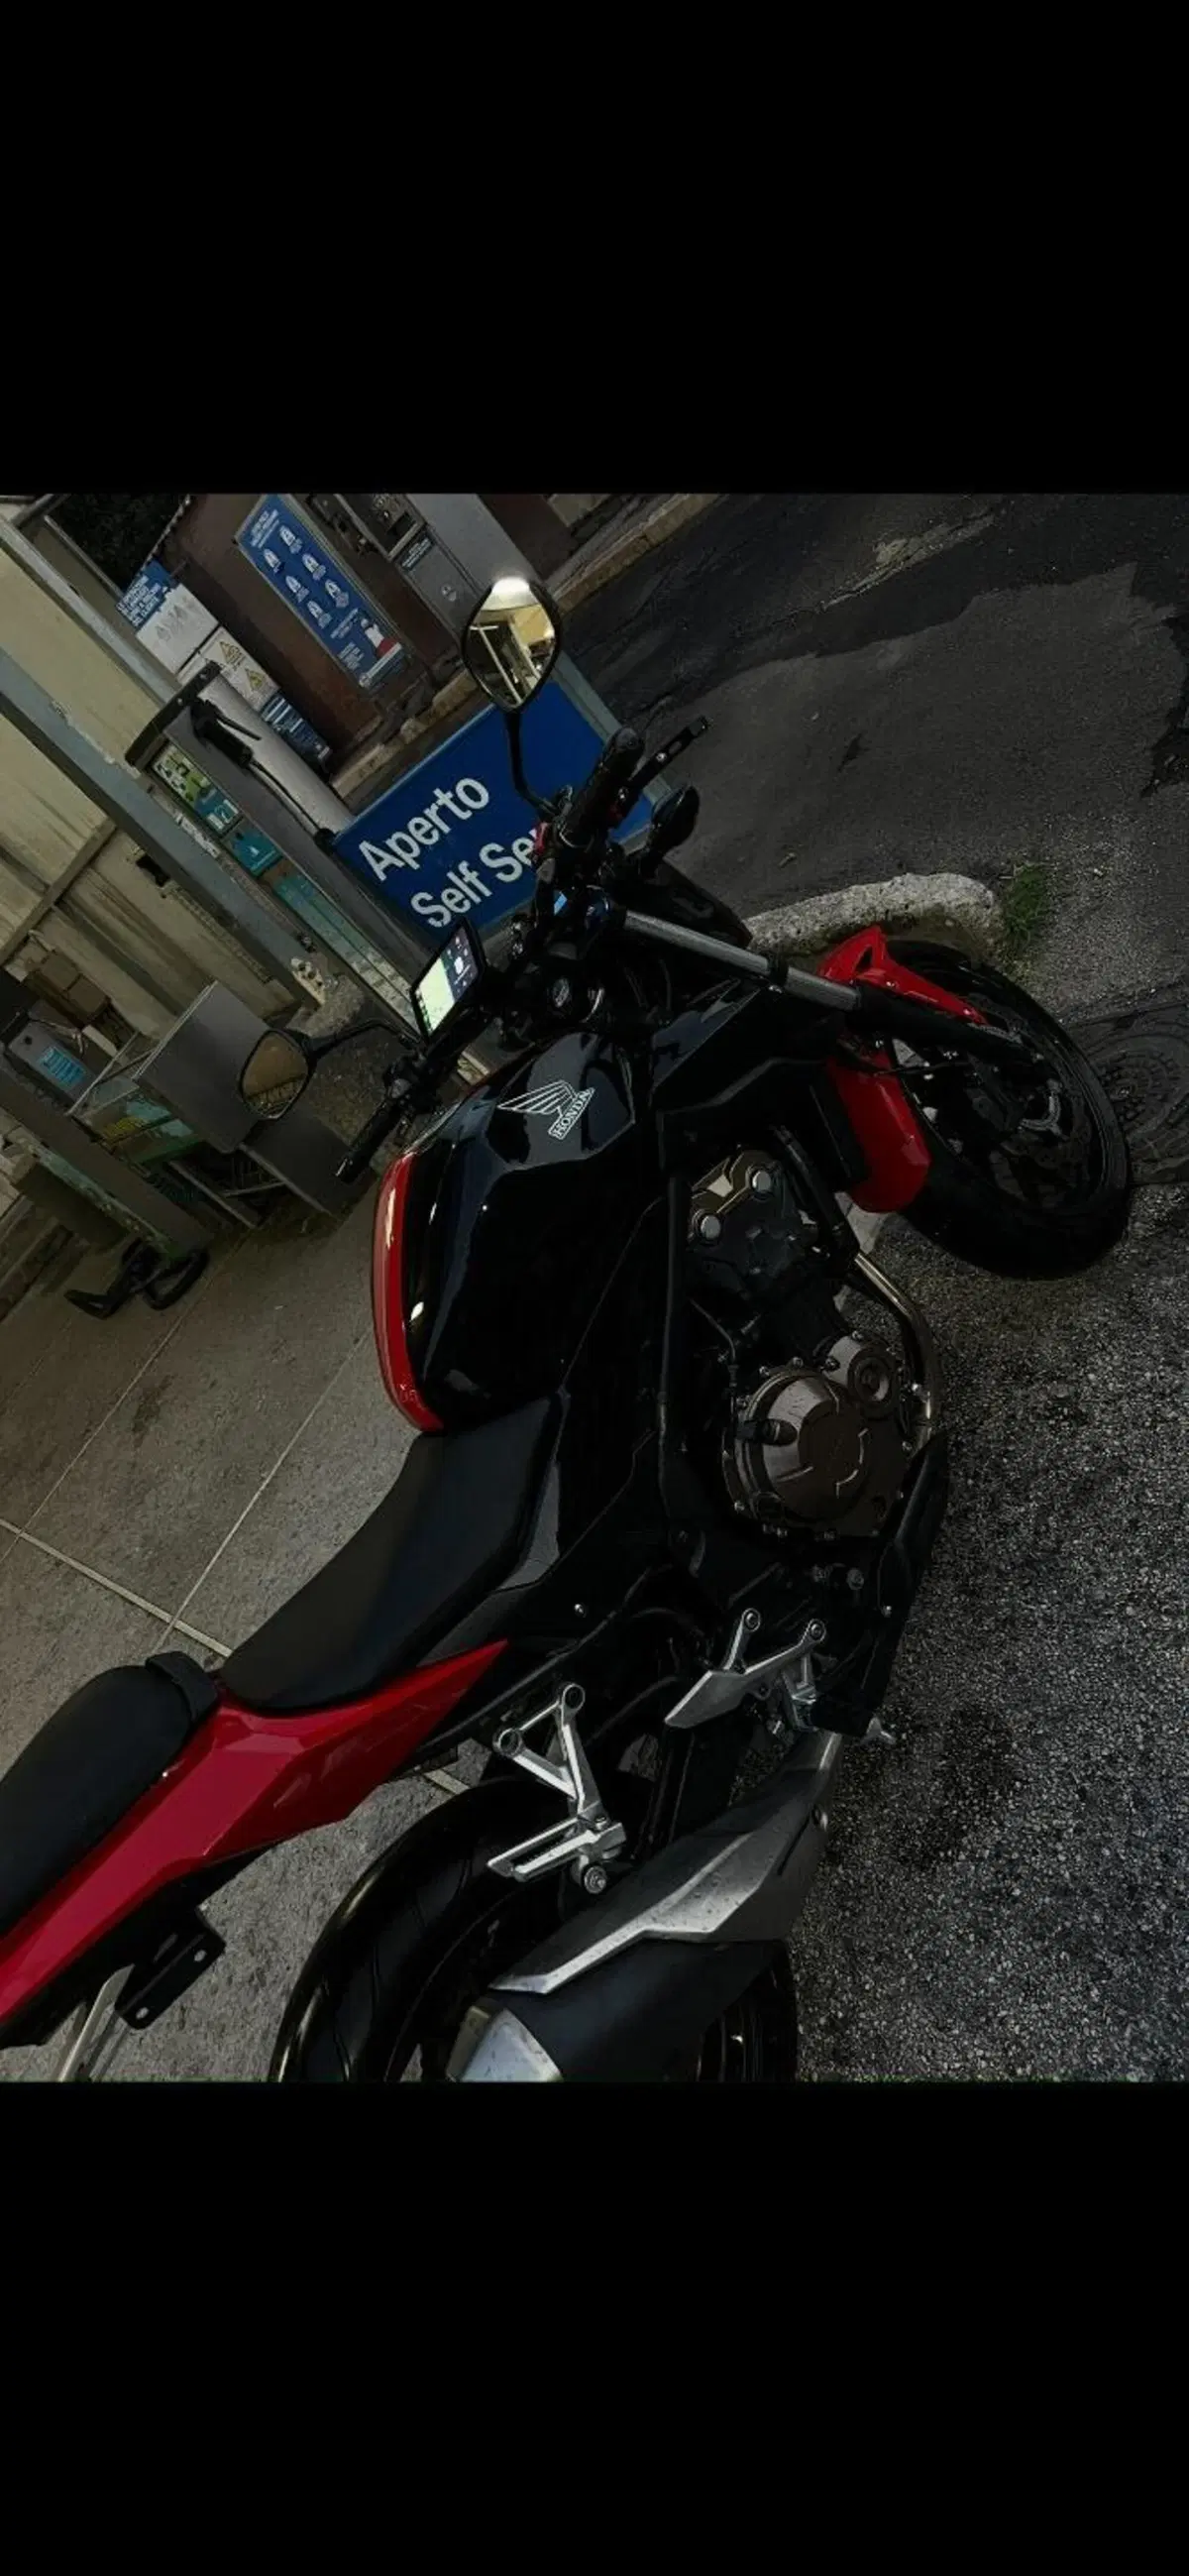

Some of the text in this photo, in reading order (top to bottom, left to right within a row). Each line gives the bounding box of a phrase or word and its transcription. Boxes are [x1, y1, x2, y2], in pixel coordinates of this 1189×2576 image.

[359, 778, 489, 881] Aperto
[410, 828, 537, 927] Self Se
[552, 1089, 593, 1137] HONDA
